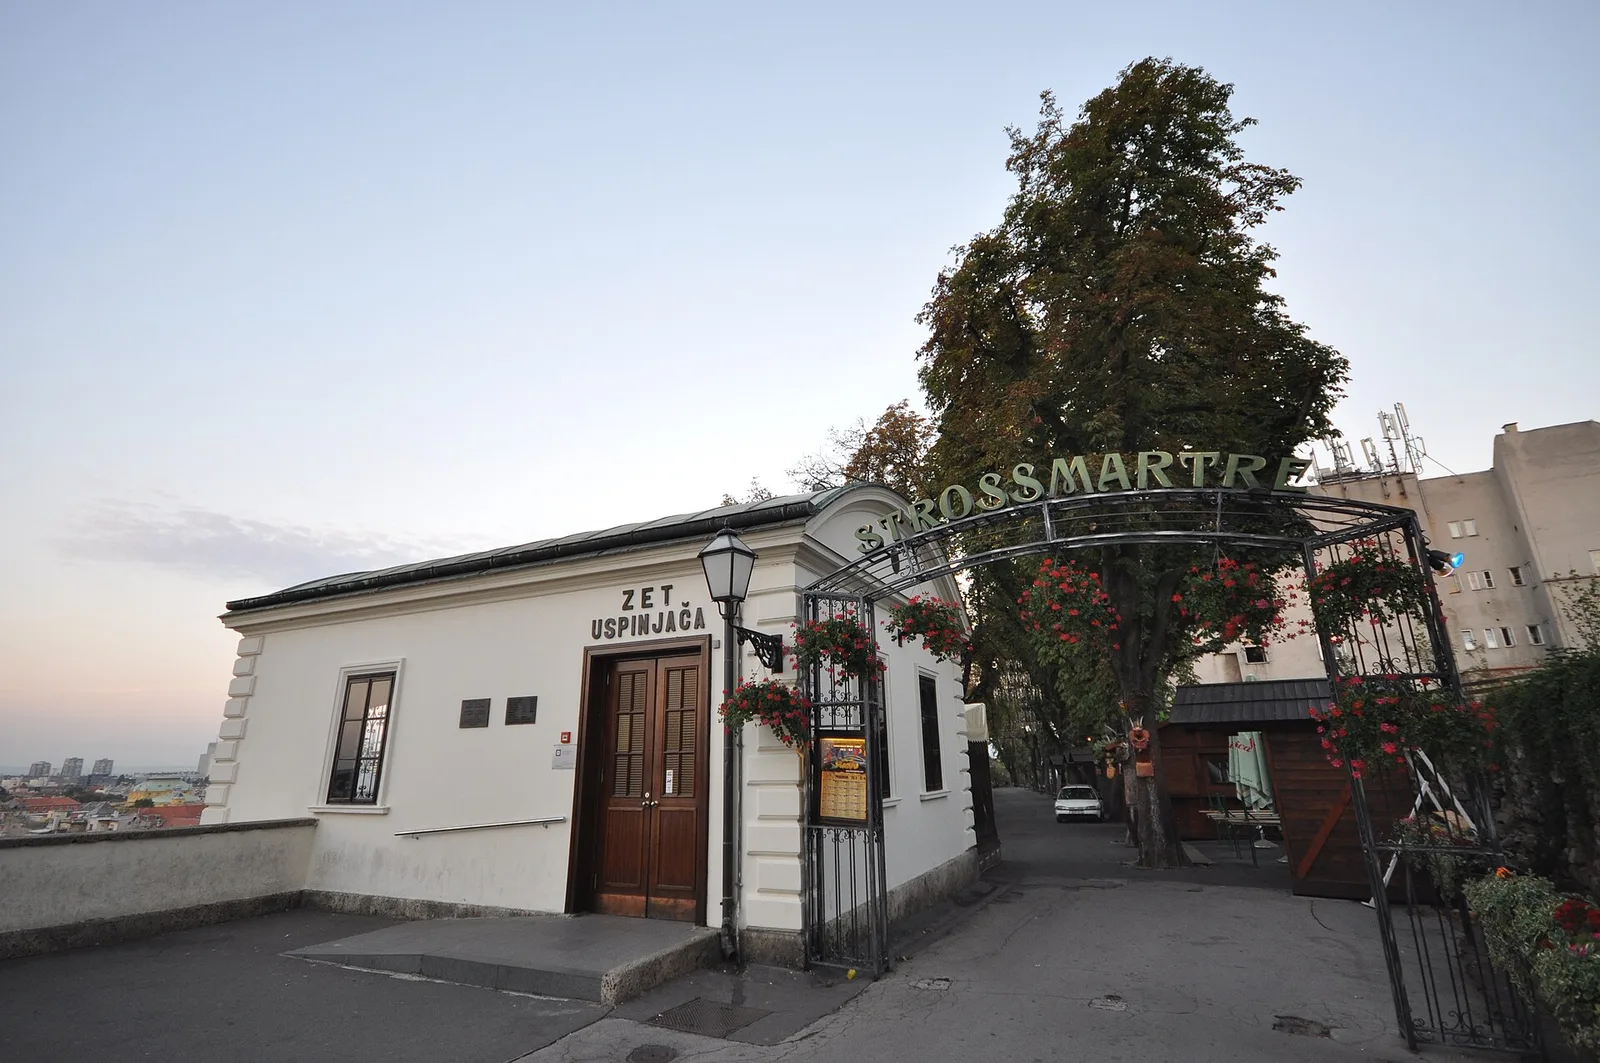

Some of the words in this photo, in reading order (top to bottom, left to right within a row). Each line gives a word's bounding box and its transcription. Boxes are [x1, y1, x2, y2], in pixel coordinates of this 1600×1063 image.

[854, 451, 1313, 554] STROSSMARTRE
[622, 585, 673, 611] ZET
[591, 601, 705, 640] USPINJAČA
